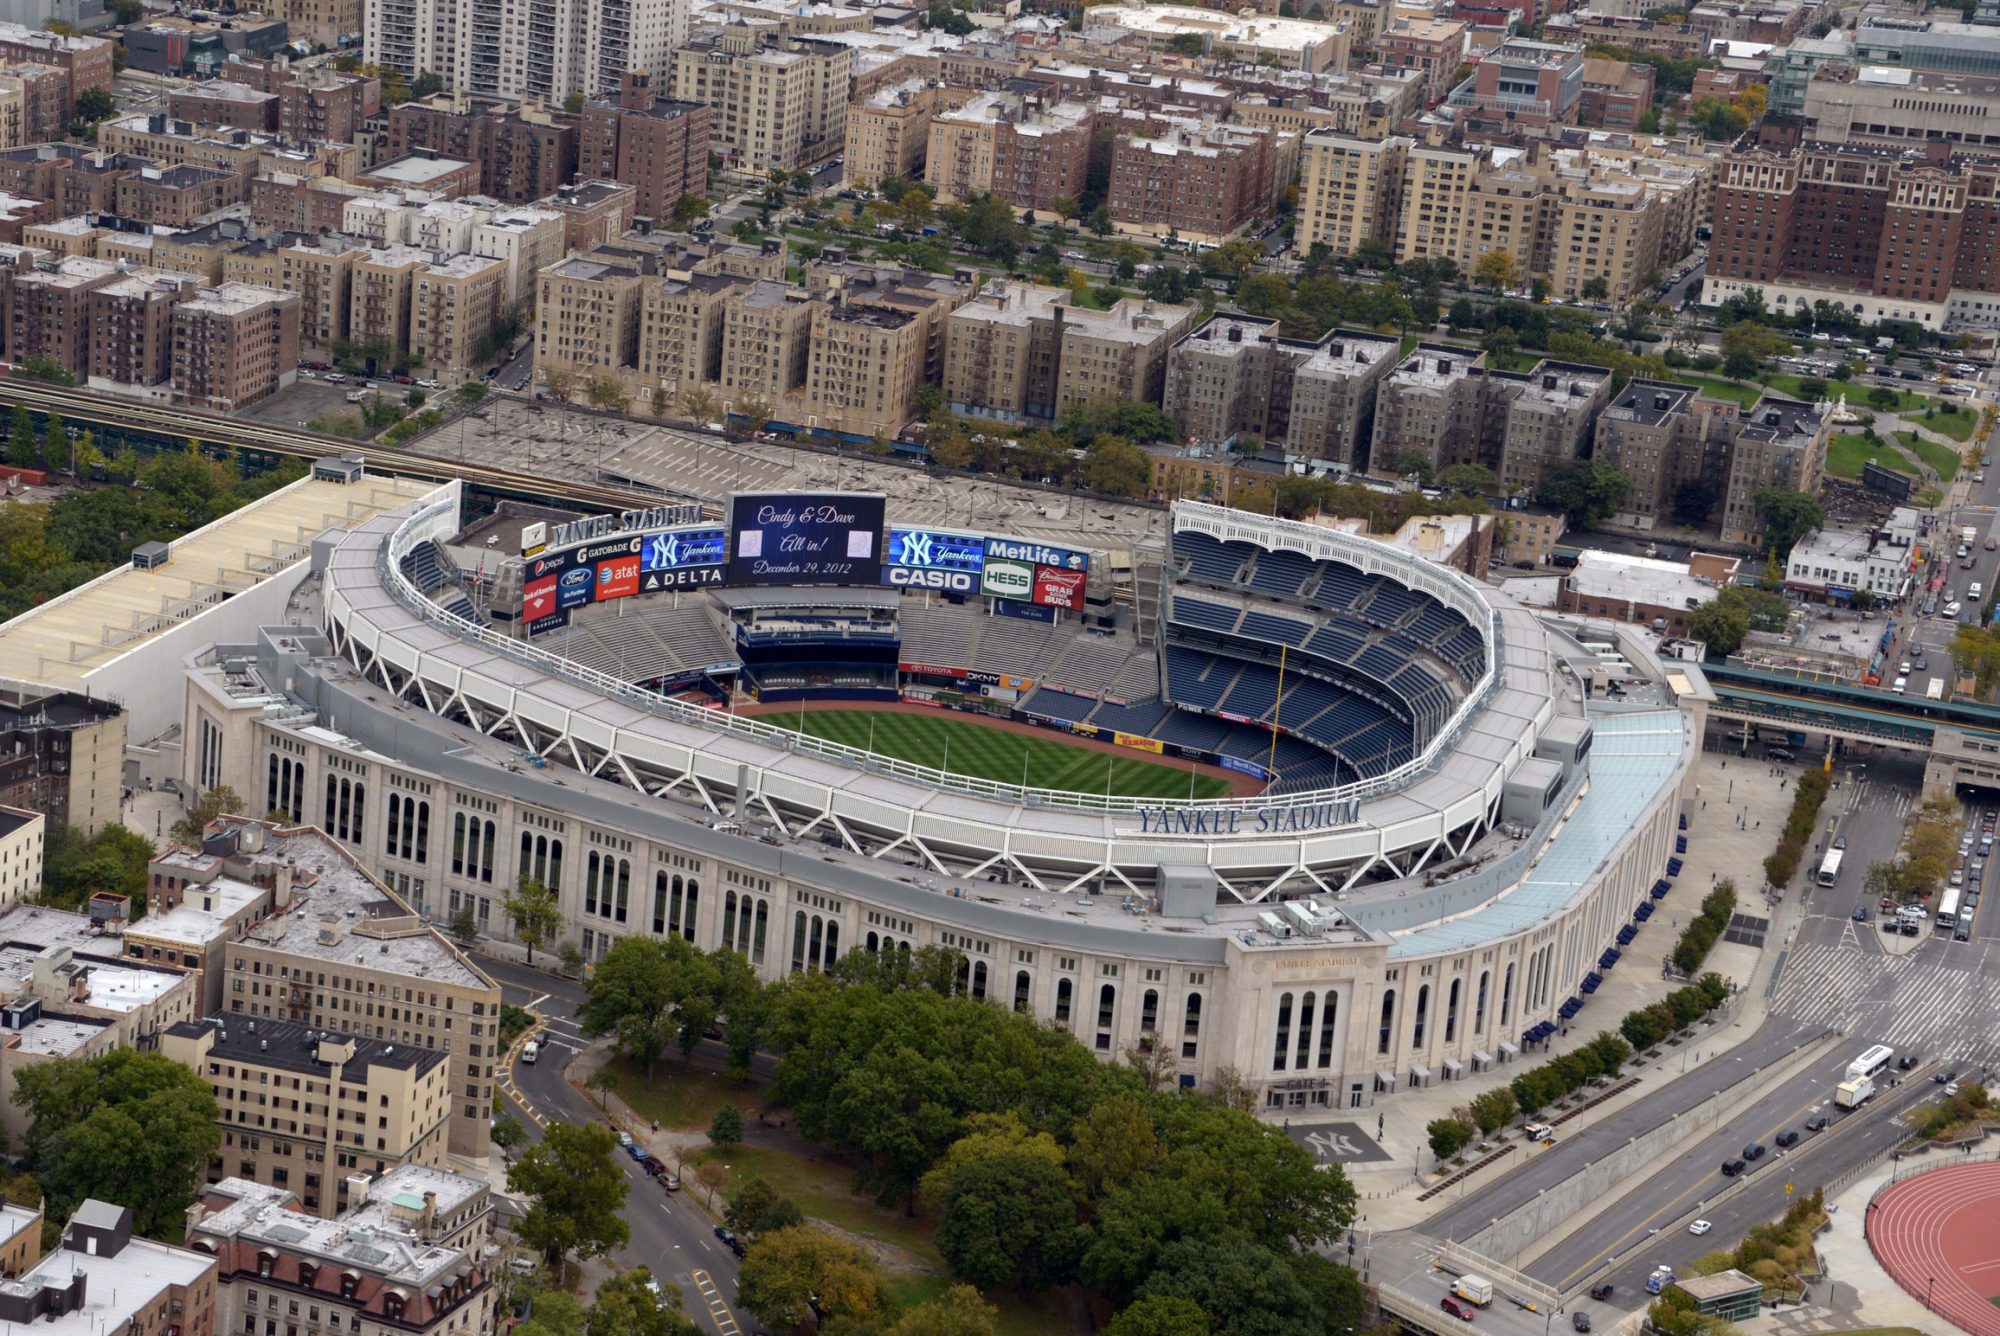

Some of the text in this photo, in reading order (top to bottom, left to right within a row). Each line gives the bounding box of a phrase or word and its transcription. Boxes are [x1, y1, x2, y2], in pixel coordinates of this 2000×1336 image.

[758, 505, 855, 528] Cindy & Dave
[552, 503, 703, 548] YANKEE STADIUM
[588, 543, 628, 558] GATORADE
[780, 534, 829, 552] All in!
[899, 531, 933, 566] NY
[650, 534, 678, 569] NY
[681, 542, 721, 561] Yankees
[936, 546, 980, 562] Yankees
[989, 541, 1060, 566] MetLife
[544, 556, 564, 571] pepsi
[752, 560, 852, 574] December 29, 2012
[566, 572, 585, 585] Ford
[614, 564, 639, 580] at&t
[664, 569, 722, 586] DELTA
[889, 568, 971, 590] CASIO
[987, 571, 1029, 587] HESS
[523, 591, 533, 601] Bank
[538, 584, 557, 595] America
[570, 589, 586, 597] Further
[1045, 584, 1073, 595] GRAB
[1044, 595, 1071, 607] BUDS
[923, 666, 952, 674] TOYOTA
[967, 672, 1000, 683] DKNY
[1137, 798, 1361, 833] YANKEE STADIUM
